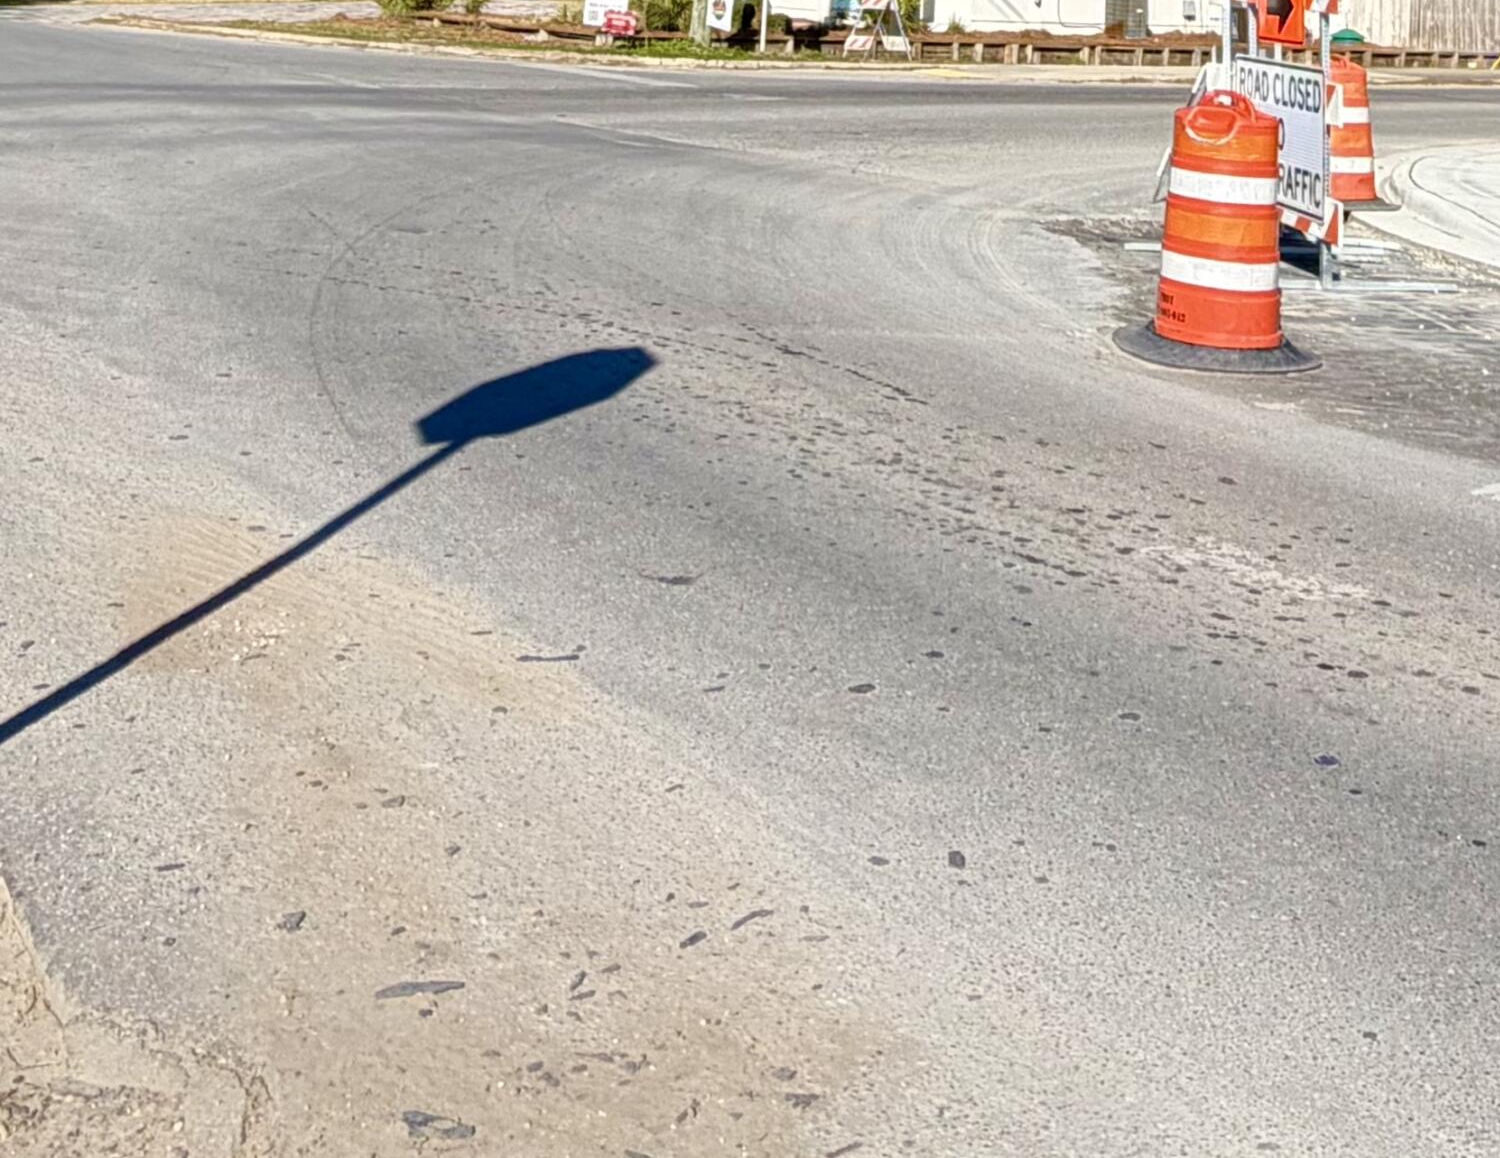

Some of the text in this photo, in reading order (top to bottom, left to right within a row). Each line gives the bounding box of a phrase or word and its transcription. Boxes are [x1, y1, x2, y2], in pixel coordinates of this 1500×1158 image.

[1240, 66, 1321, 113] ROAD CLOSED
[1278, 162, 1321, 209] RAFFIC
